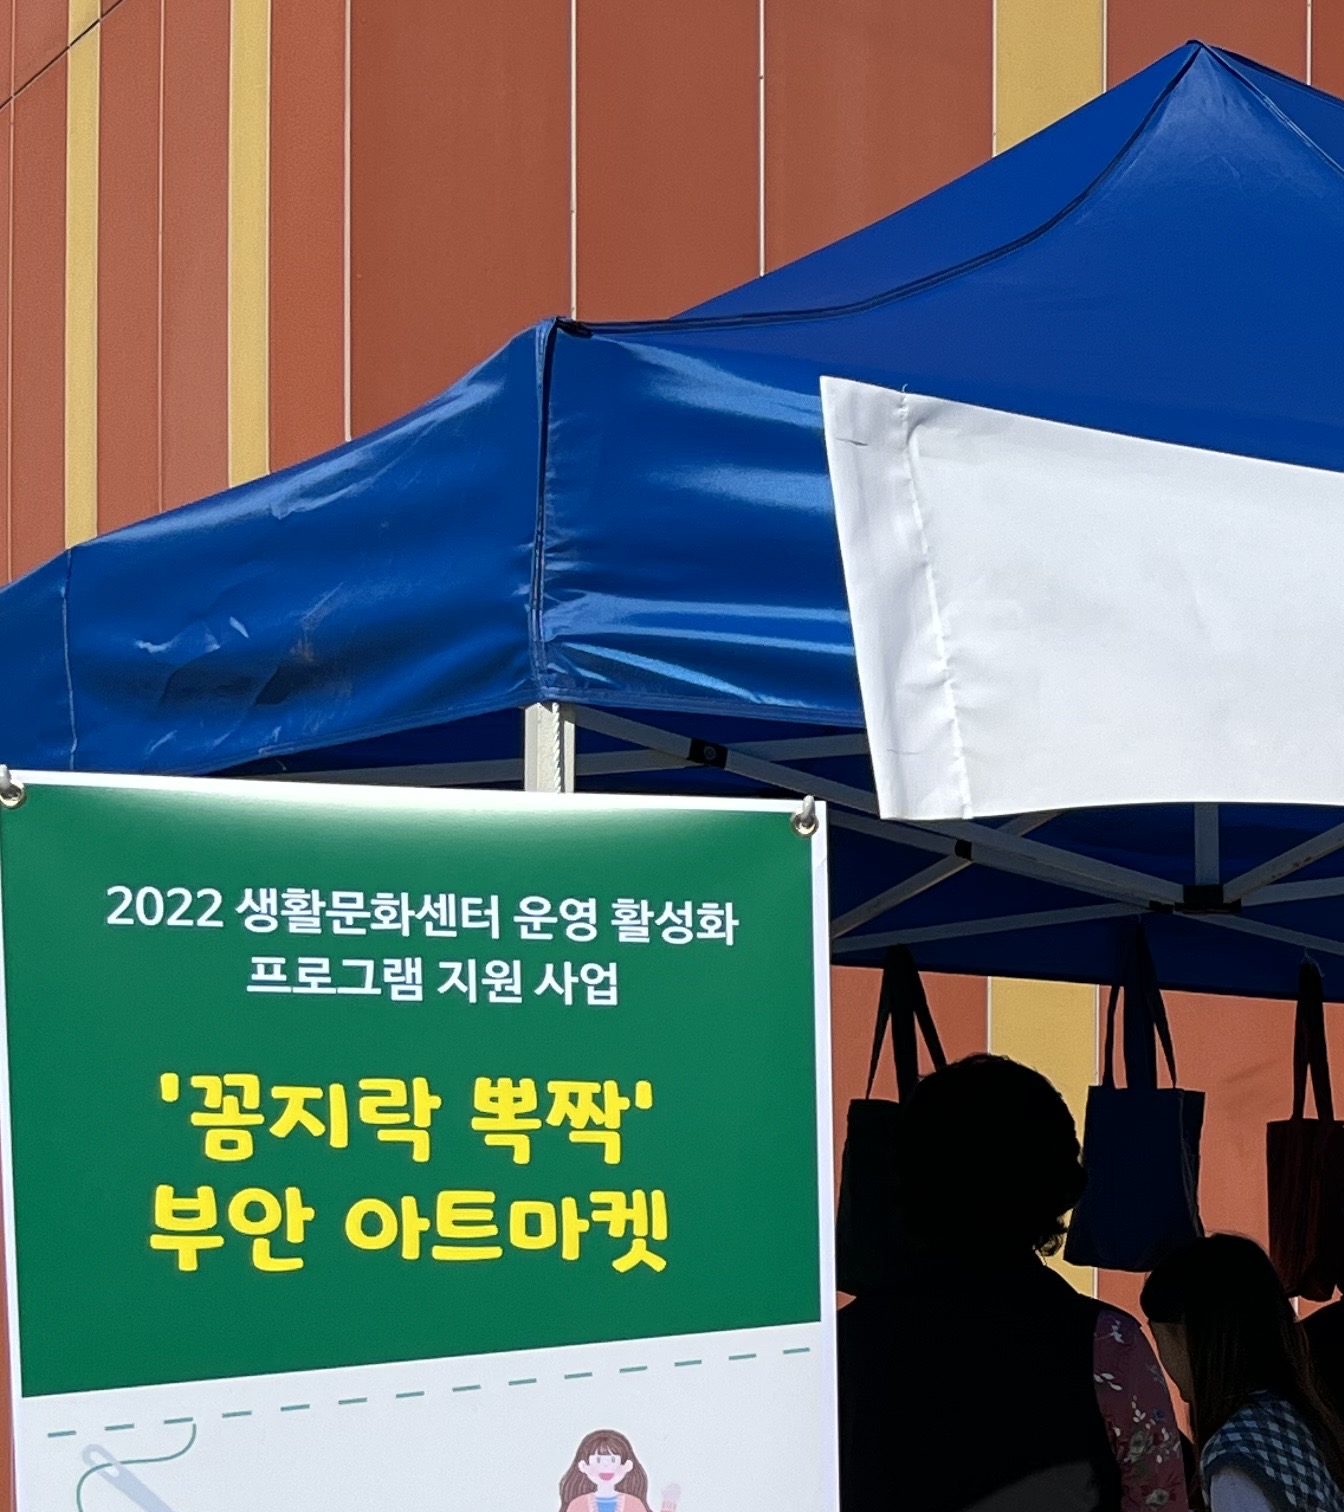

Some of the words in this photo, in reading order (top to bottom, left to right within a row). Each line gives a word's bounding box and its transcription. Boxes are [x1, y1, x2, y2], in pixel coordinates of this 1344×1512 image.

[105, 885, 225, 929] 2022
[235, 885, 500, 941] 생활문화센터
[513, 895, 599, 942] 운영
[611, 897, 740, 947] 활성화
[246, 955, 425, 1003] 프로그램
[437, 960, 523, 1004] 지원
[534, 961, 619, 1007] 사업
[159, 1072, 442, 1164] '꼼지락
[471, 1076, 654, 1166] 뽁짝'
[149, 1183, 315, 1274] 부안
[344, 1188, 670, 1275] 아트마켓
